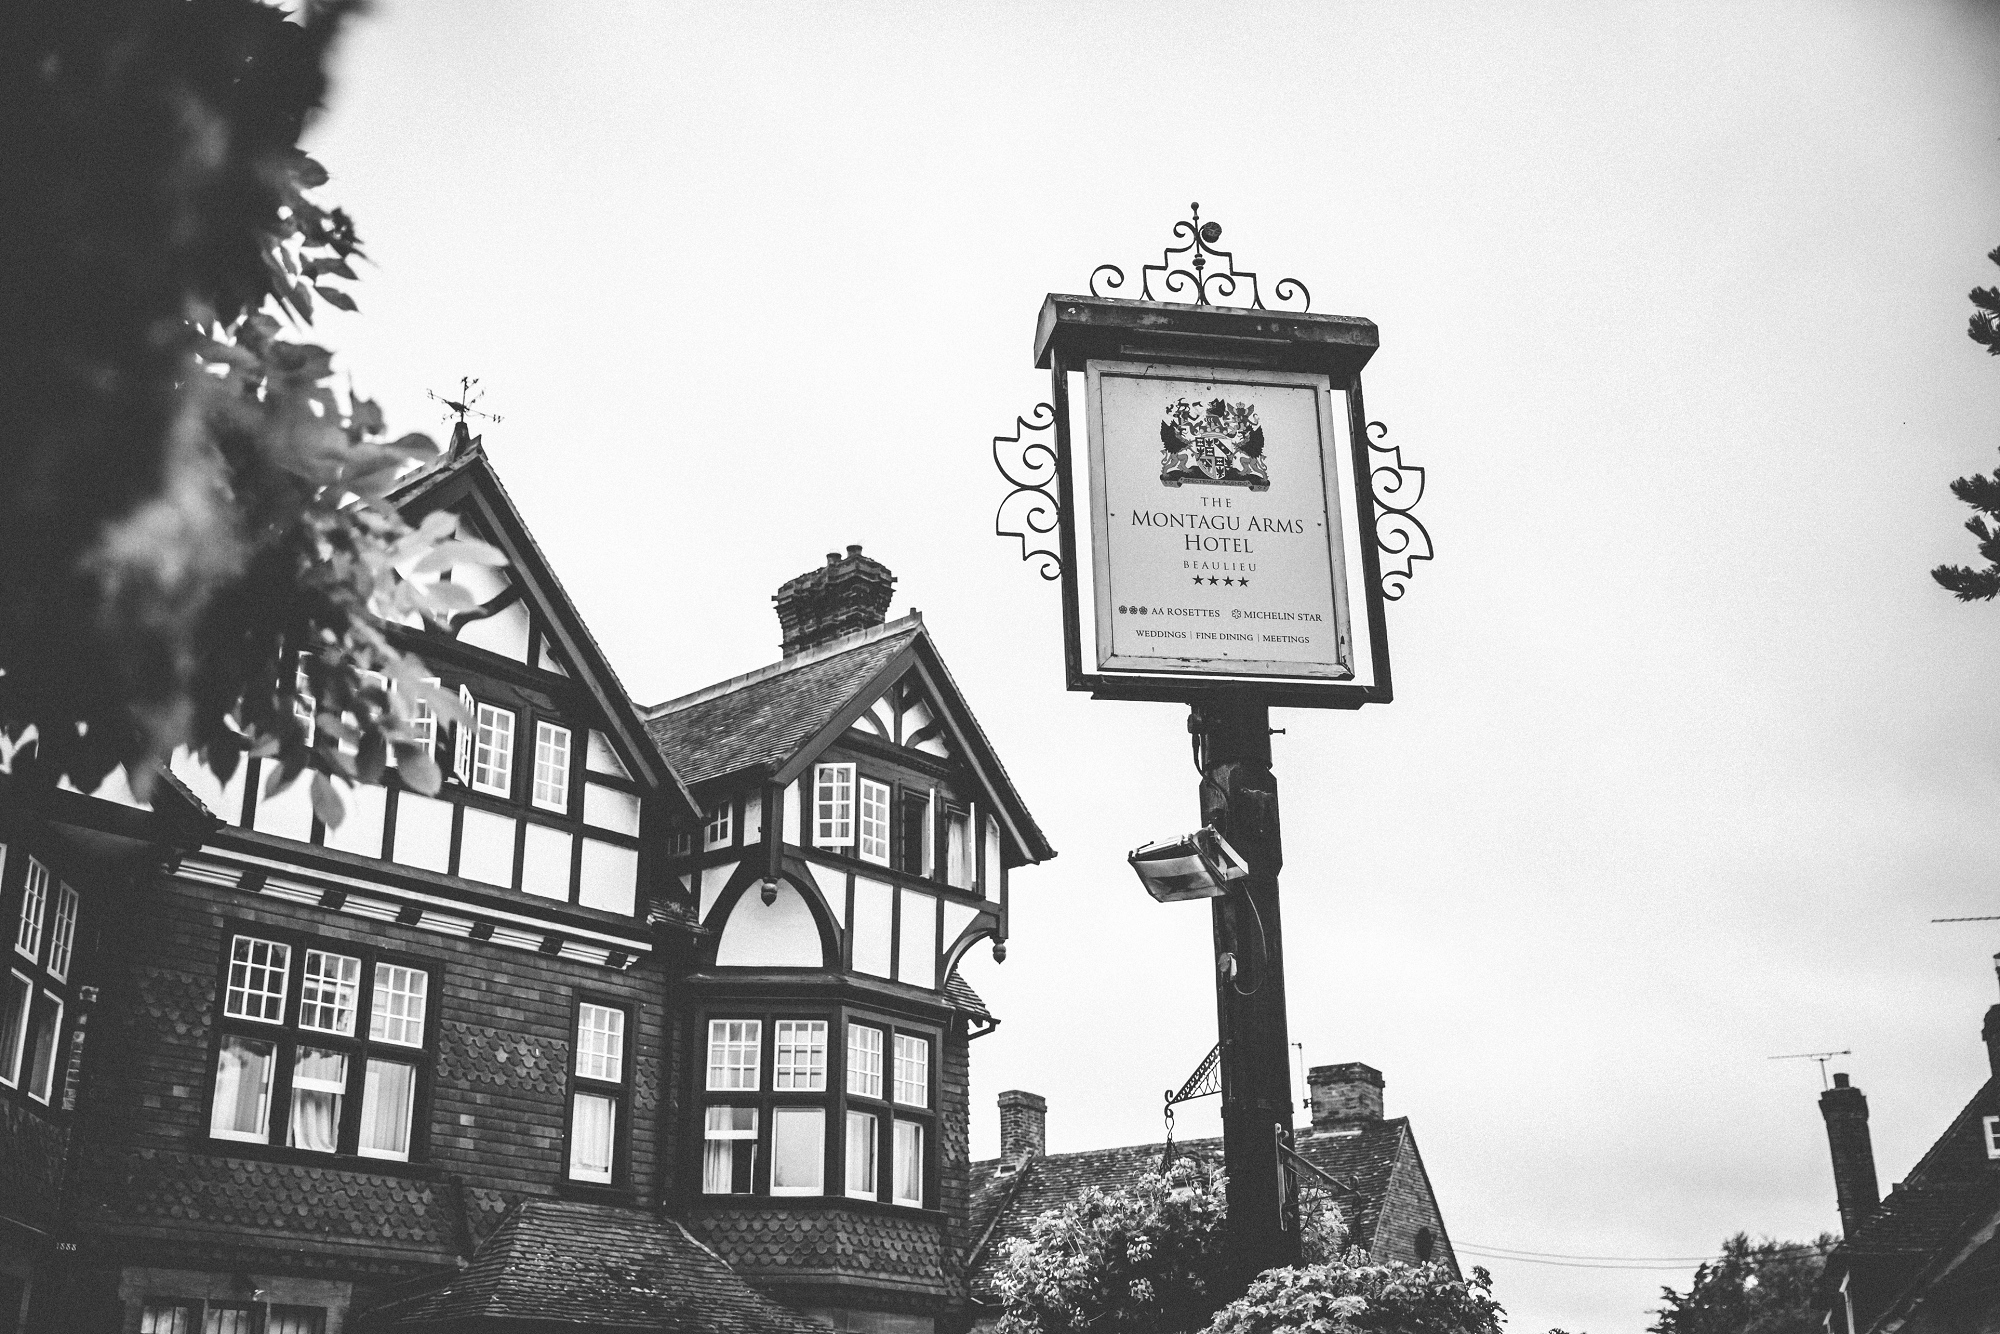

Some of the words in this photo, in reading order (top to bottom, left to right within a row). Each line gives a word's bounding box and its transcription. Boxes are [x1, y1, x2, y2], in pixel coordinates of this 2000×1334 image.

[1200, 496, 1232, 508] THE
[1131, 509, 1240, 531] MONTAGU
[1247, 515, 1304, 534] ARMS
[1184, 533, 1254, 554] HOTEL
[1183, 560, 1257, 572] BEAULIEU
[1151, 607, 1165, 616] AA
[1167, 608, 1220, 618] ROSETTES
[1244, 610, 1295, 621] MICHELIN
[1297, 613, 1323, 622] STAR
[1135, 629, 1187, 639] WEDDINGS
[1196, 631, 1217, 640] FINE
[1219, 632, 1254, 642] DINING
[1262, 634, 1310, 644] MEETINGS
